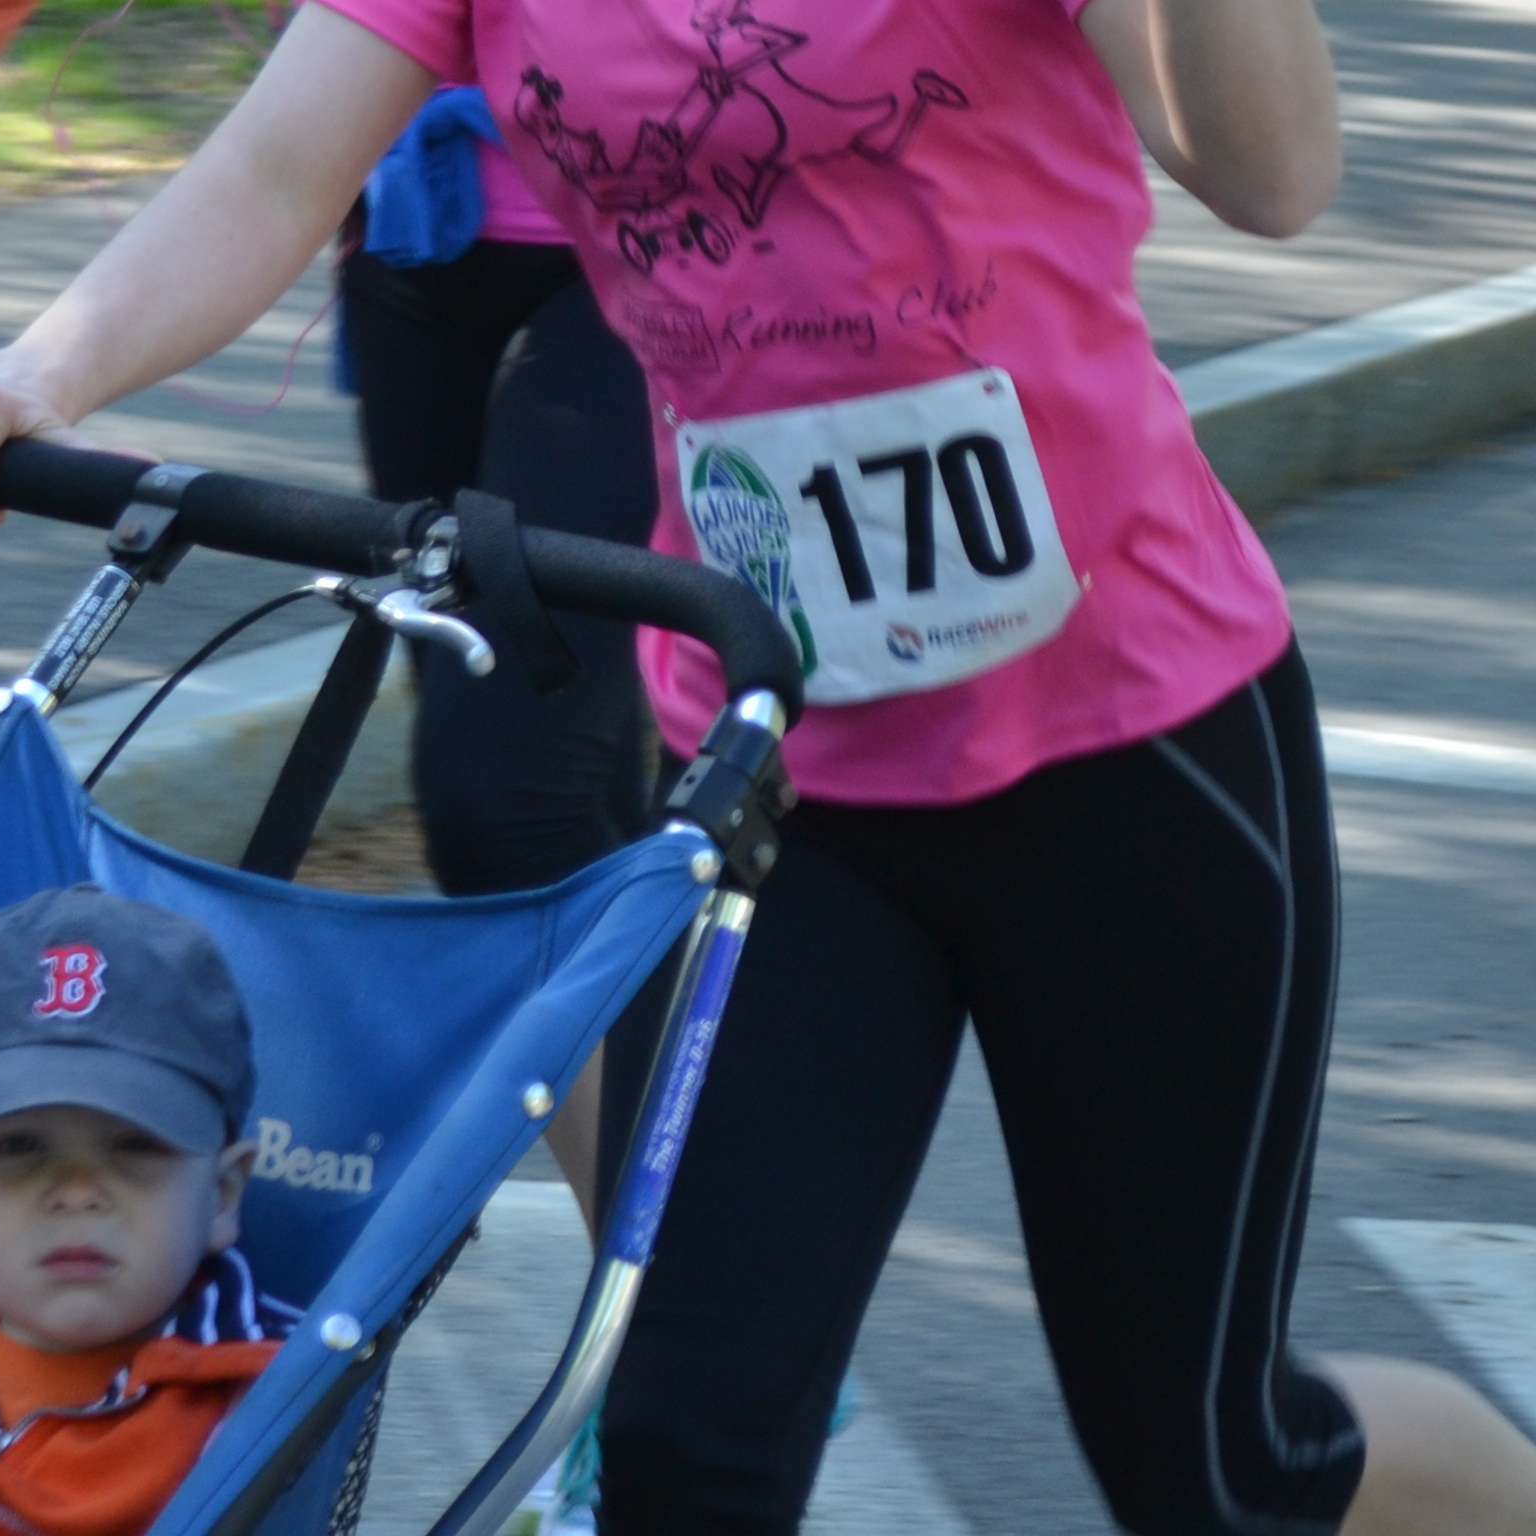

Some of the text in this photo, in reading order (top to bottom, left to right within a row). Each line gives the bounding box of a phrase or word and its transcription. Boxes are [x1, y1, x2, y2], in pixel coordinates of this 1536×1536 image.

[691, 492, 791, 537] WONDER
[798, 433, 1036, 605] 170
[32, 943, 108, 1019] B
